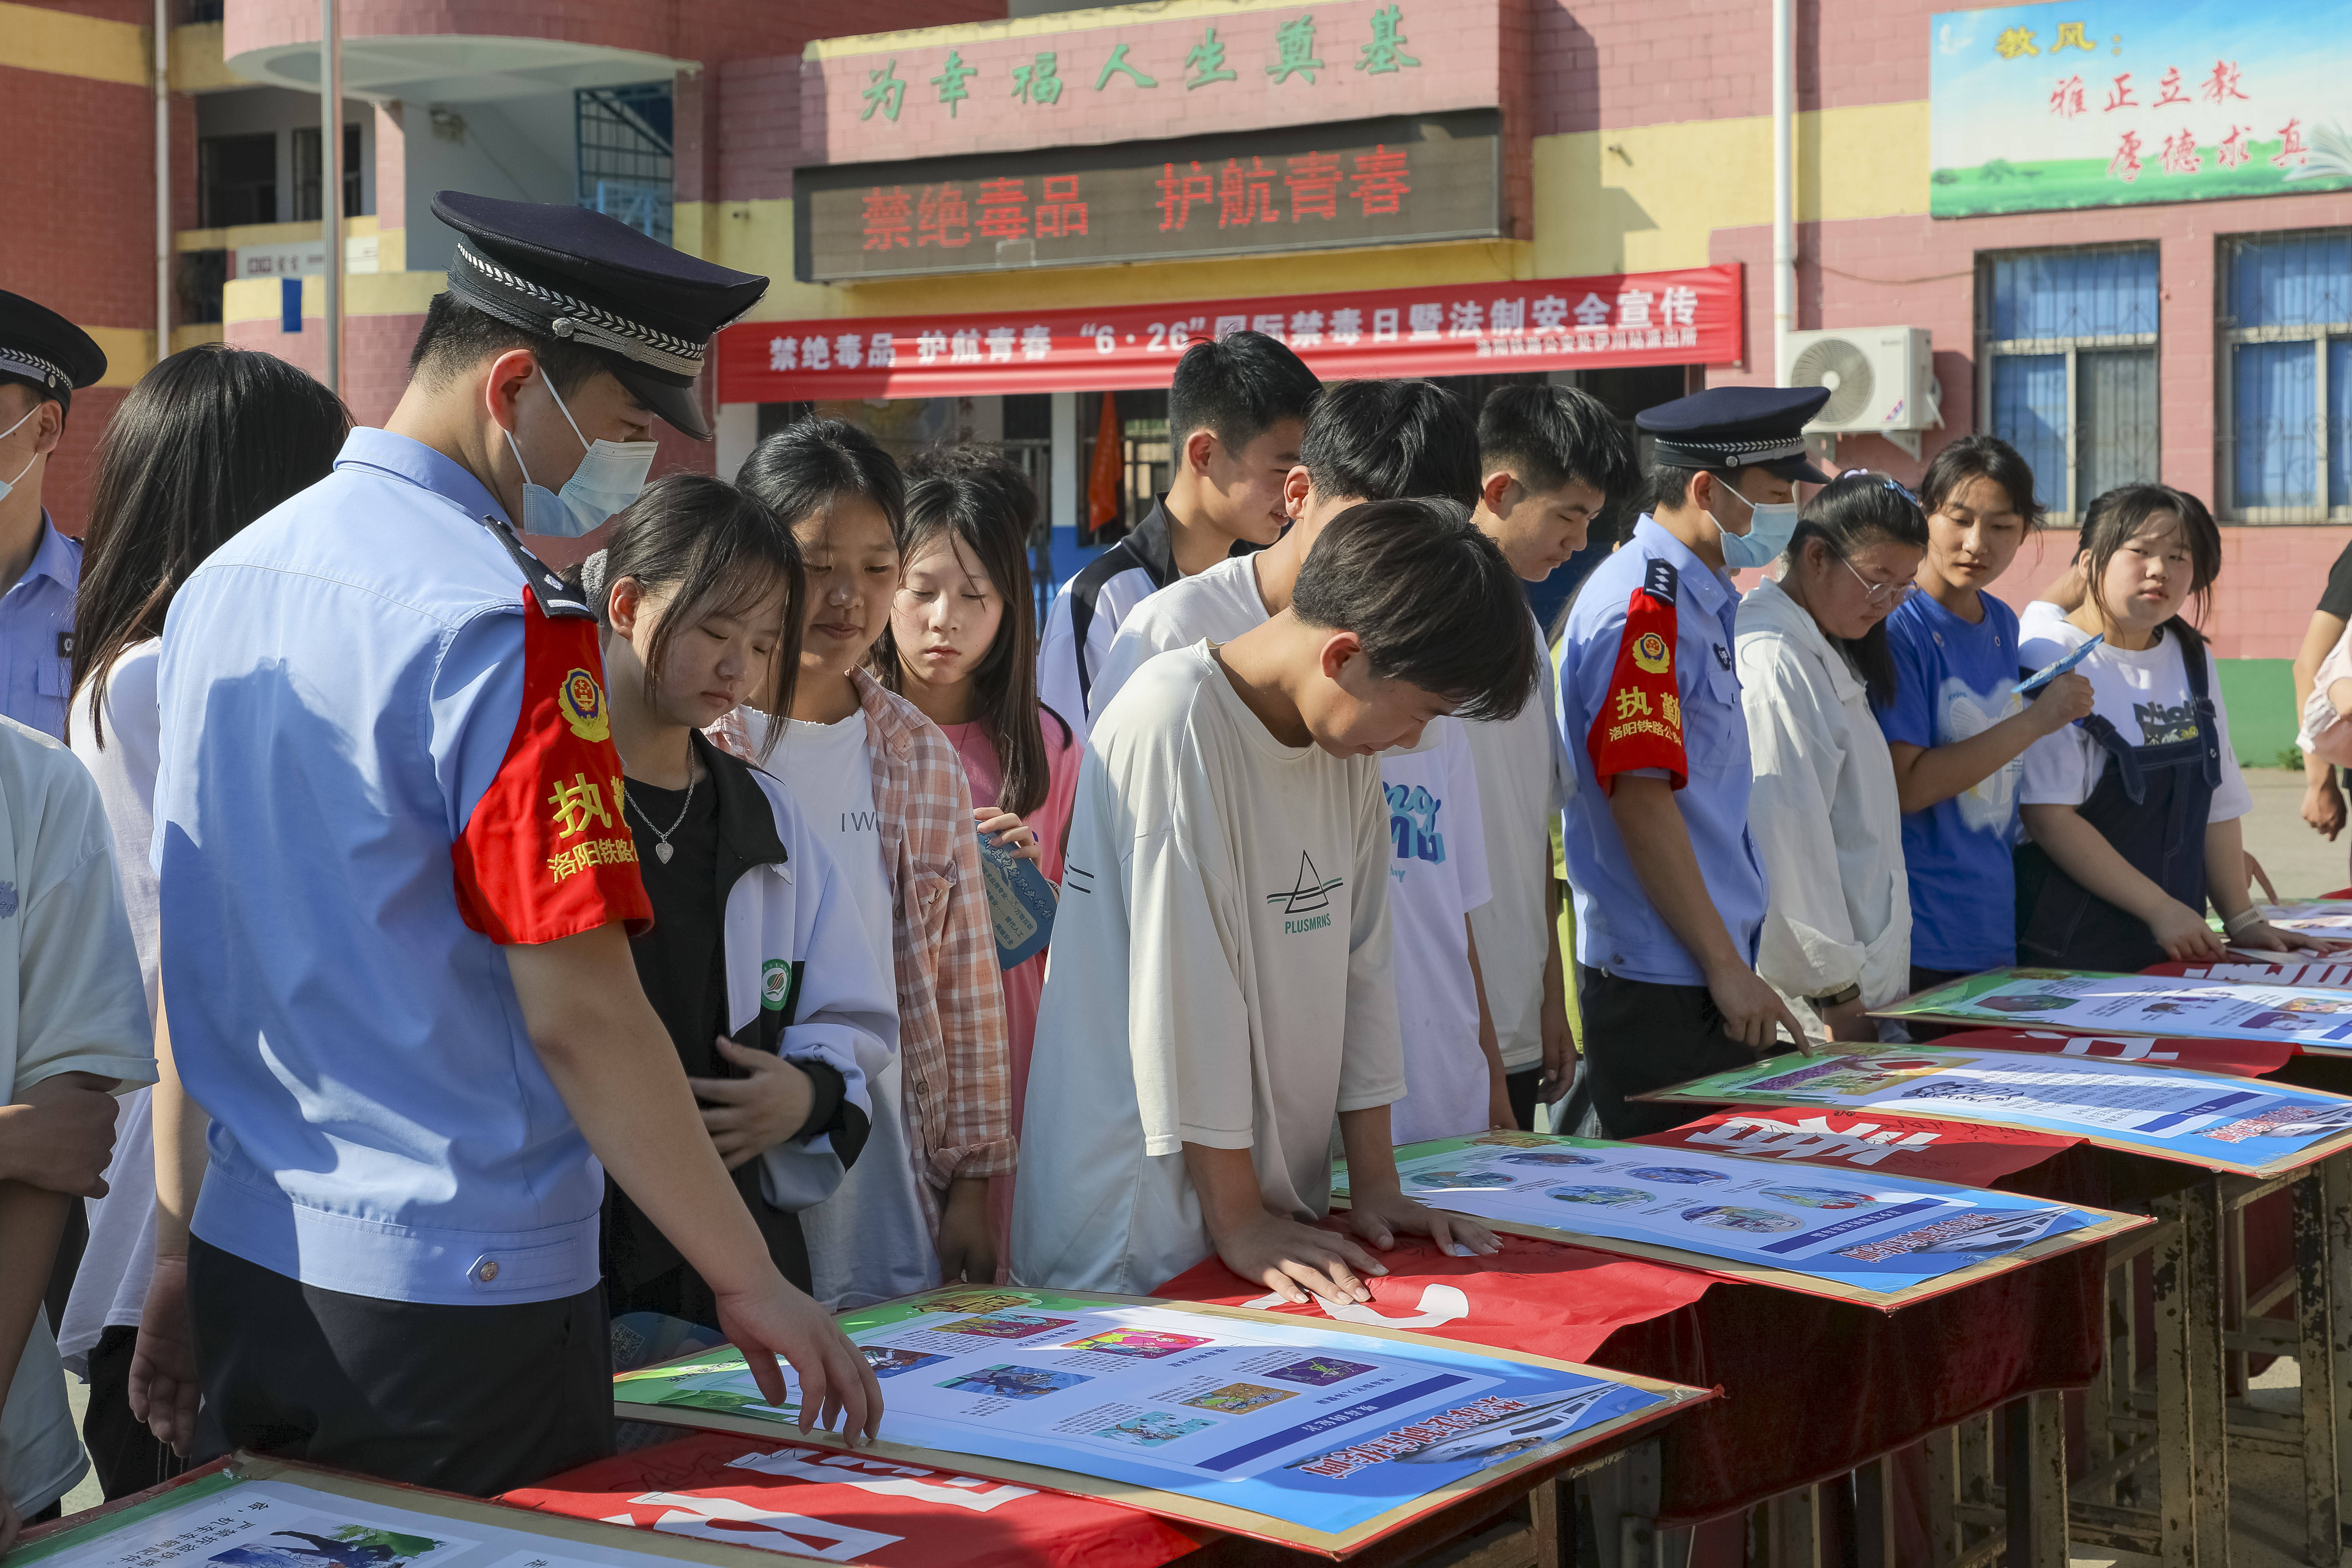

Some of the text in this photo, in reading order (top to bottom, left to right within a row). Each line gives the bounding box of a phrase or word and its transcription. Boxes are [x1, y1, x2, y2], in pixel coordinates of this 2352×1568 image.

[860, 8, 1421, 121] 为幸福人生奠基
[2049, 60, 2251, 119] 雅正立教
[2108, 117, 2309, 182] 厚德求真
[862, 145, 1411, 252] 禁绝毒品 护航青春
[770, 333, 896, 371] 禁绝毒品
[917, 326, 1052, 364] 护航青春
[1616, 686, 1681, 730] 执勤
[1285, 913, 1331, 934] PLUSMRNS
[1838, 1213, 2004, 1263] 禁毒法制宣传画
[1292, 1396, 1532, 1479] 禁毒法制宣传画
[1296, 1405, 1382, 1432] 吸毒的危害
[125, 1520, 258, 1568] 严禁拆盗铁路
